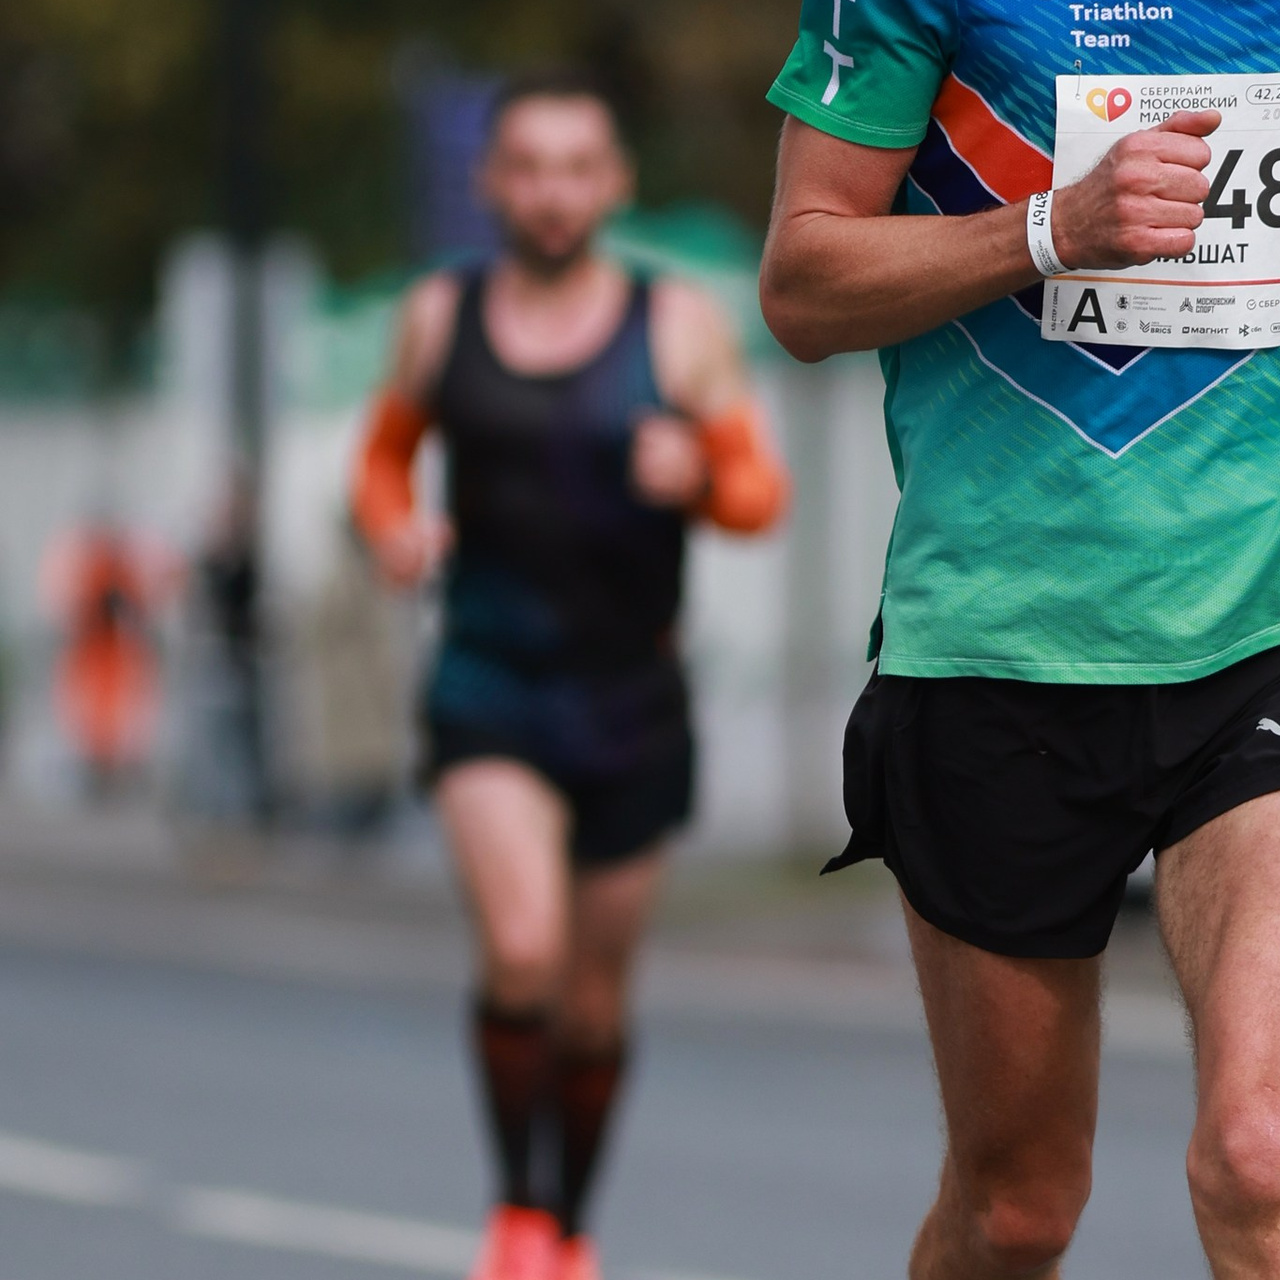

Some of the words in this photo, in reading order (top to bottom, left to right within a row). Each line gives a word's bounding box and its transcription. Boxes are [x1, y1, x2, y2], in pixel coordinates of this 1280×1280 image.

[1069, 1, 1173, 21] Triathlon
[1070, 30, 1131, 48] Team
[1140, 85, 1212, 96] СБЕРПРАЙМ
[1140, 95, 1238, 109] МОСКОВСКИЙ
[1258, 299, 1280, 308] СБЕР
